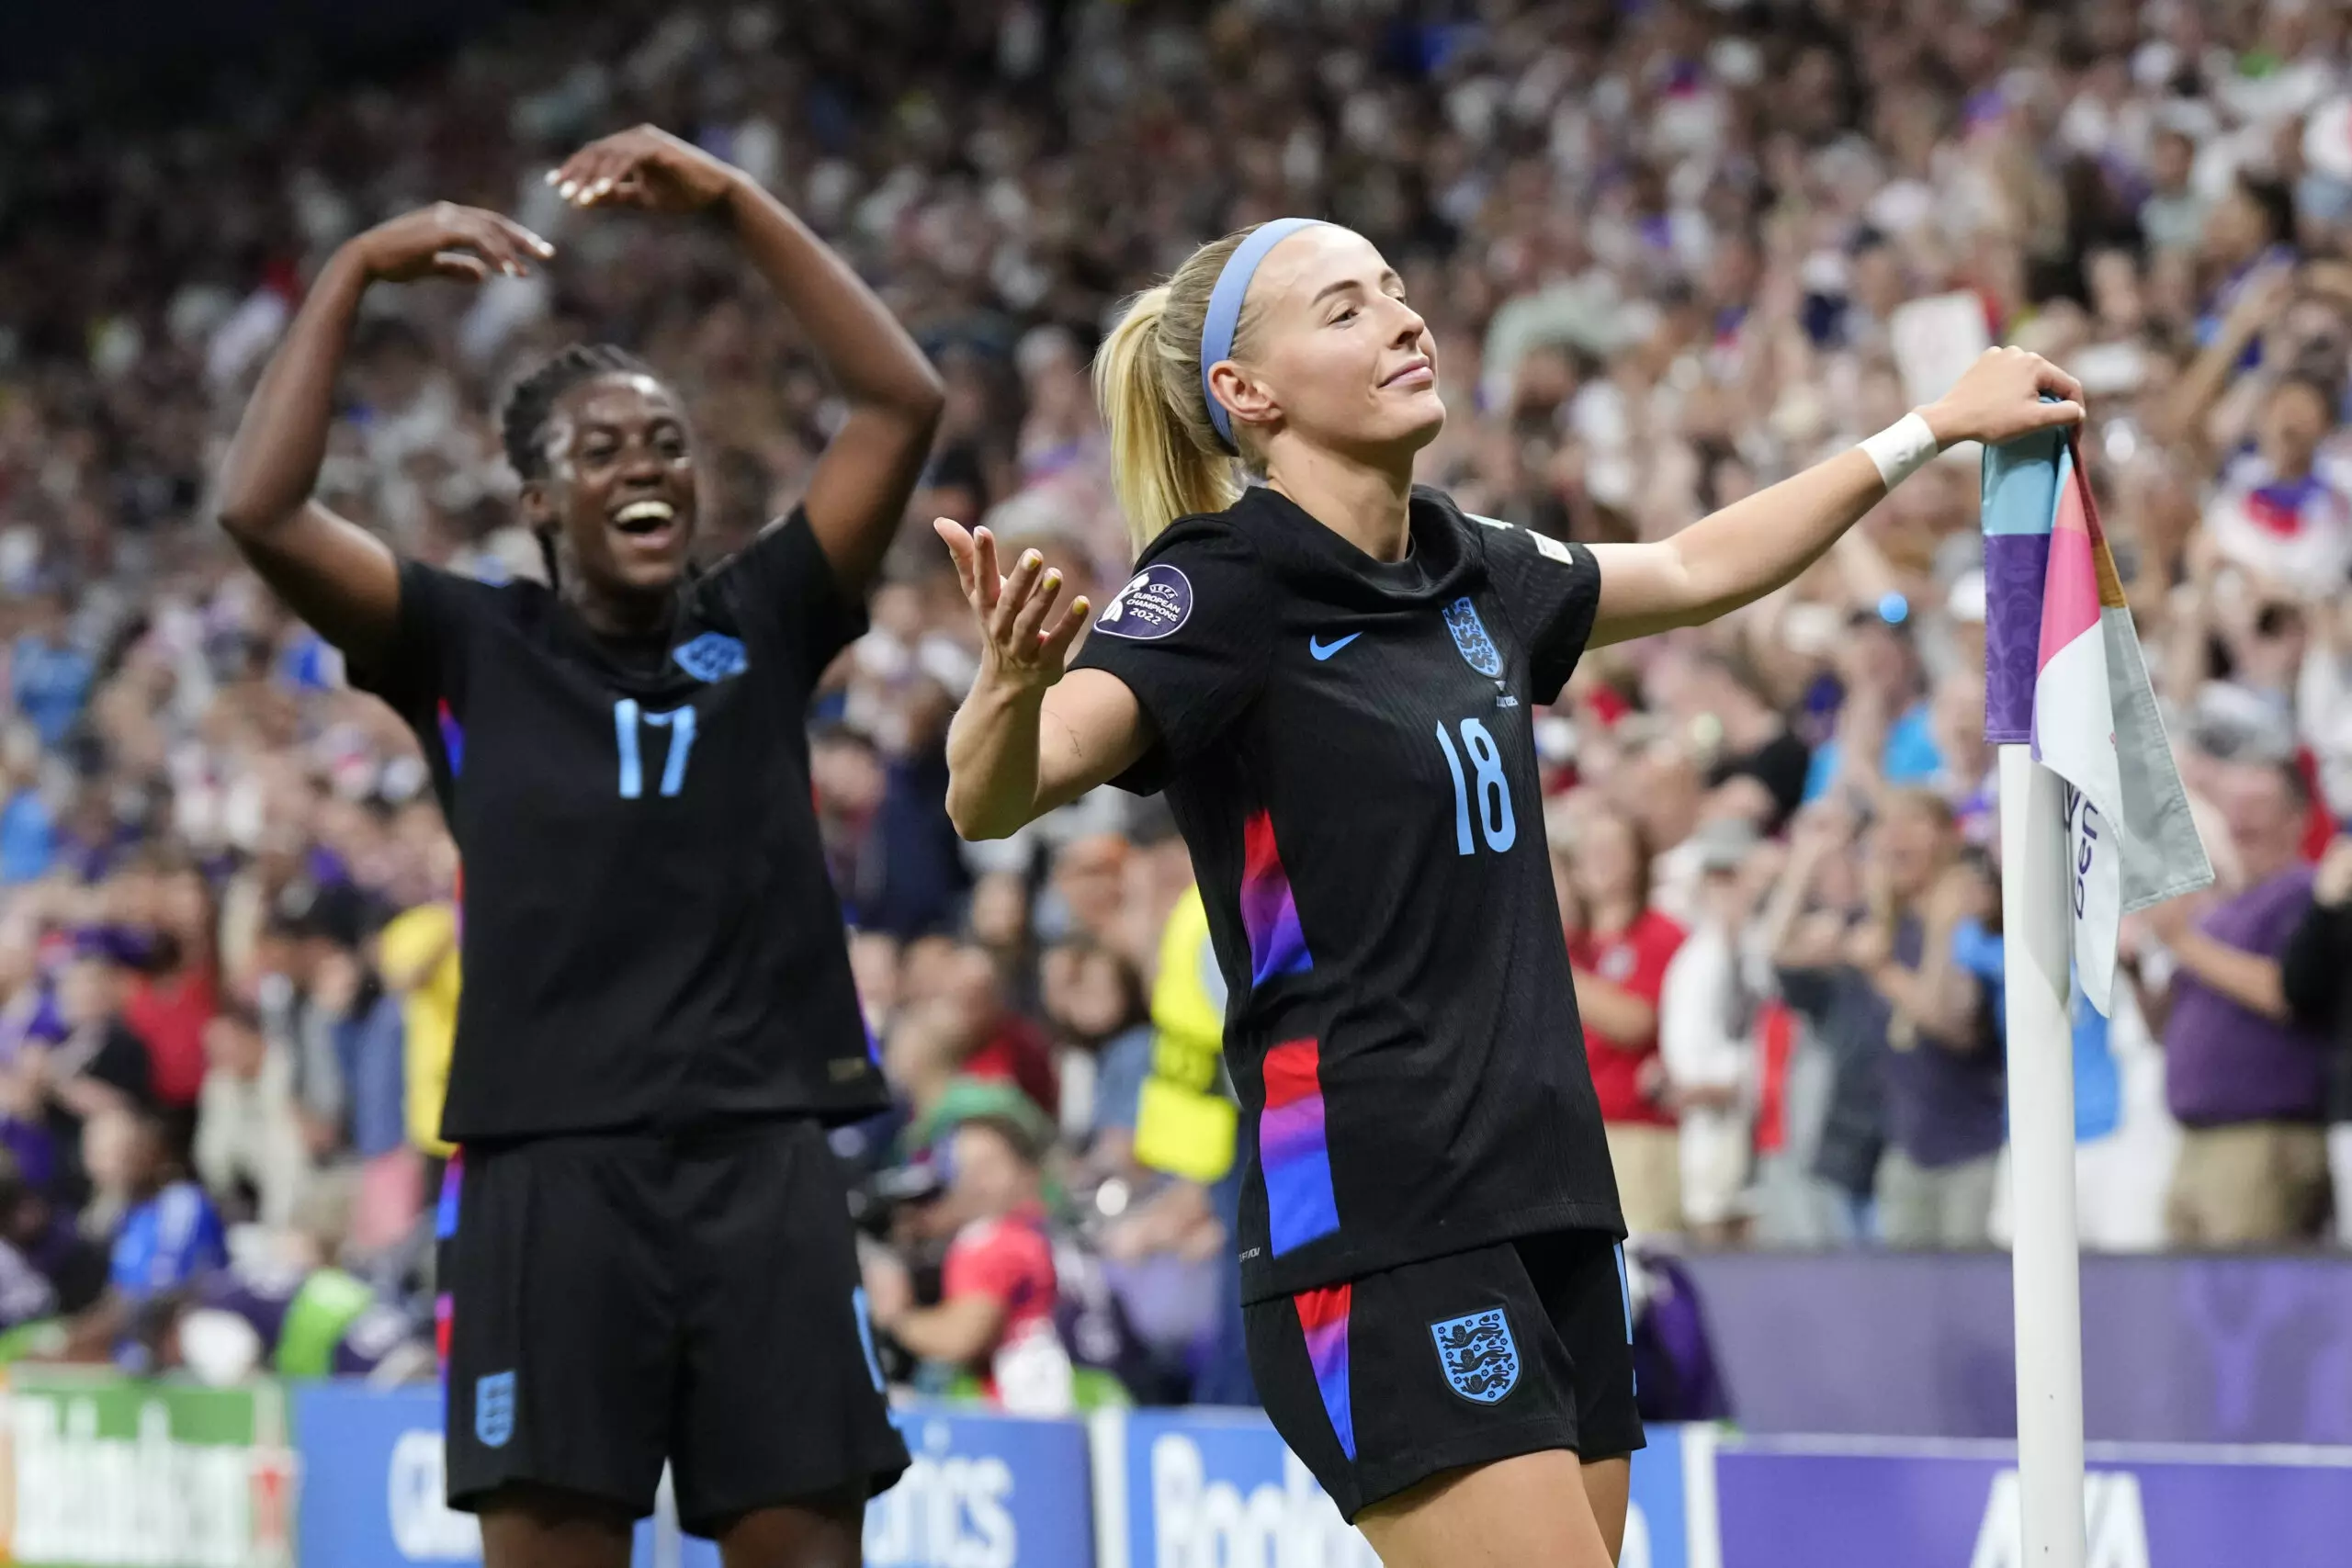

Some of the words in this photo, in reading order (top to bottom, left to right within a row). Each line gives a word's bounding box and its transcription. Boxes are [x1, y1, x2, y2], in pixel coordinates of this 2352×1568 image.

[1133, 592, 1181, 613] EUROPEAN
[1149, 584, 1177, 599] UEFA
[1126, 599, 1178, 623] CHAMPIONS
[1129, 607, 1162, 626] 2022
[615, 698, 697, 799] 17
[1436, 718, 1517, 855] 18
